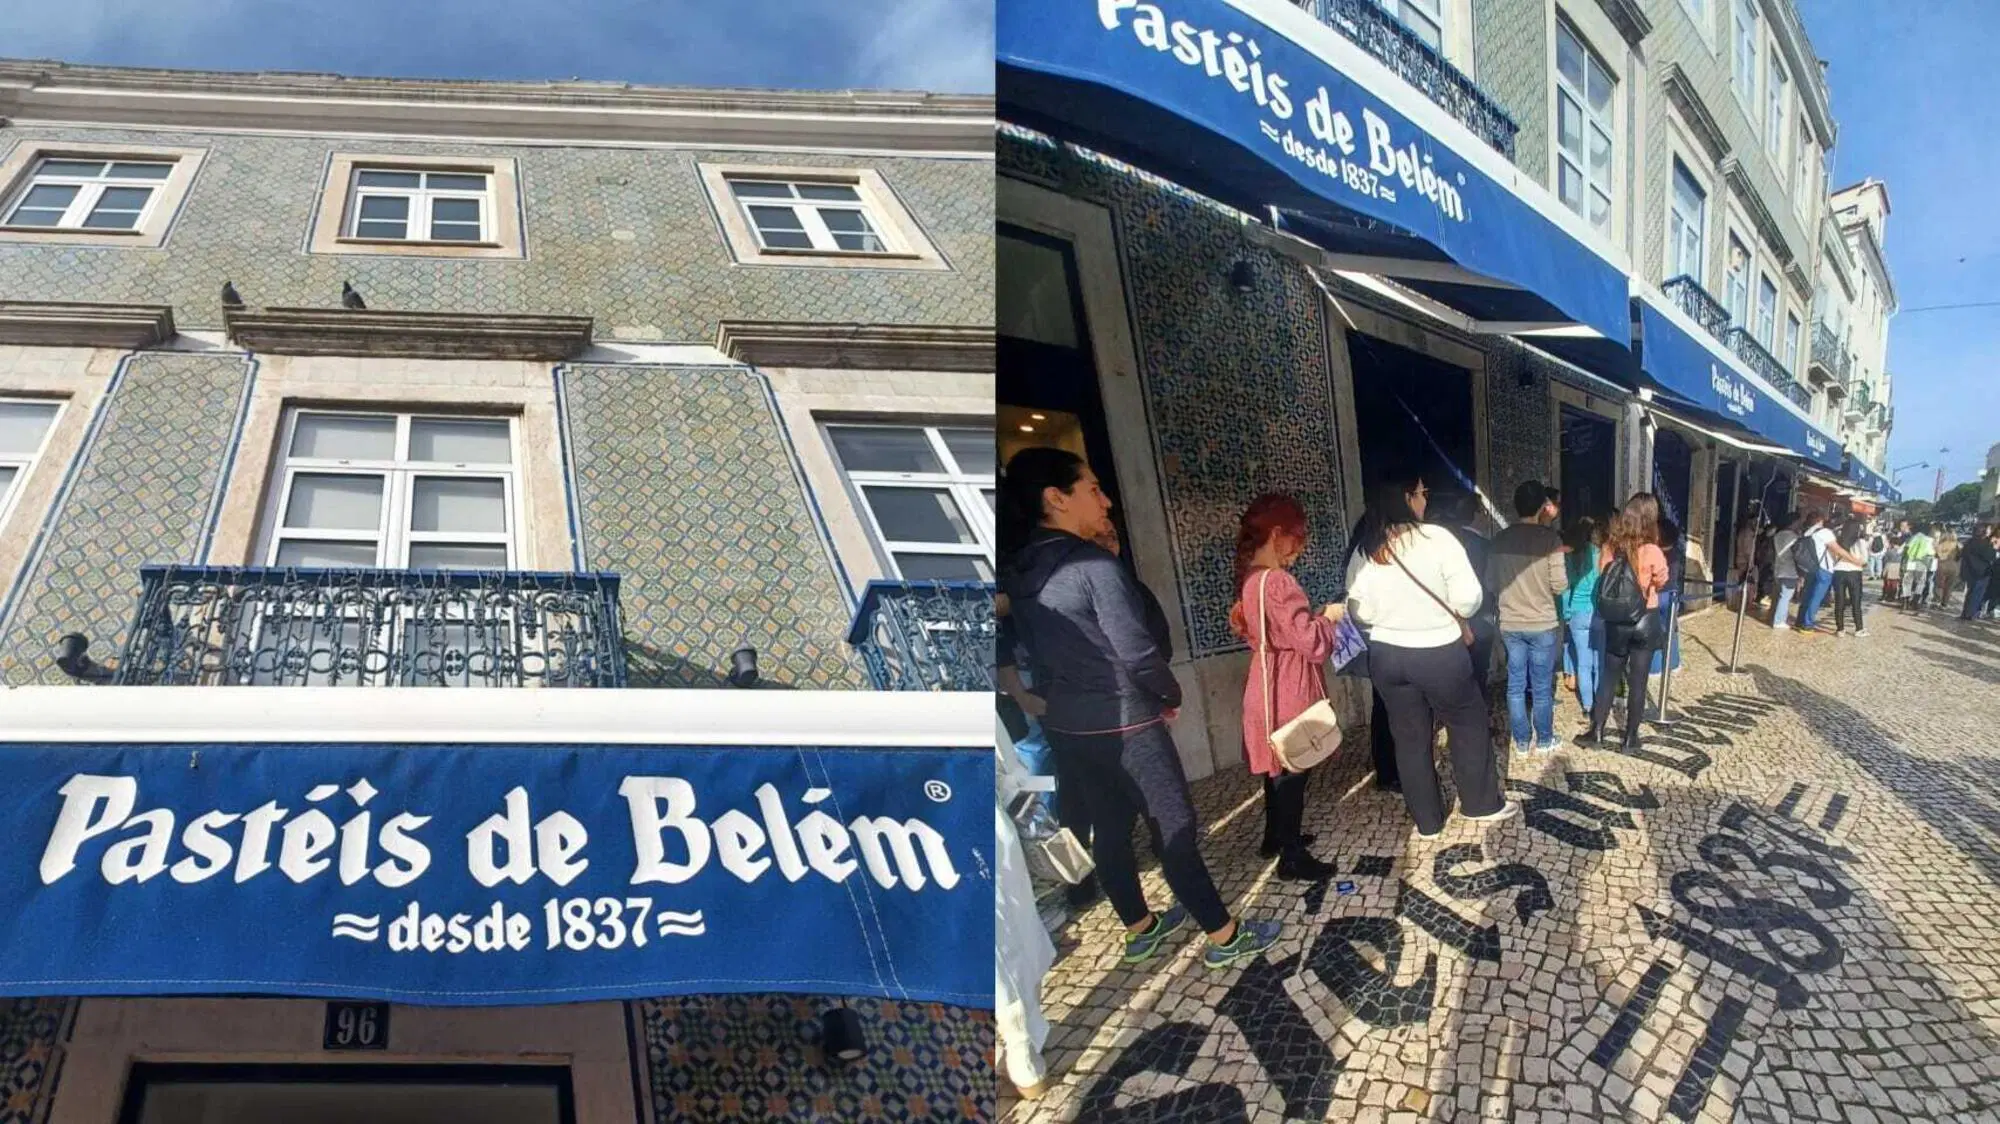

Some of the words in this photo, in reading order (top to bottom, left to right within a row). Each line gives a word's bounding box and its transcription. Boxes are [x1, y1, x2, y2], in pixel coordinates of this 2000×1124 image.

[1282, 129, 1338, 178] desde
[1340, 158, 1379, 199] 1837
[1304, 86, 1355, 155] de
[1362, 107, 1464, 222] Belém
[39, 773, 432, 888] Pastéis
[466, 786, 589, 888] de
[618, 775, 961, 892] Belém
[388, 901, 531, 953] desde
[543, 897, 653, 951] 1837
[1634, 802, 1861, 1011] 1837
[337, 1006, 377, 1045] 96
